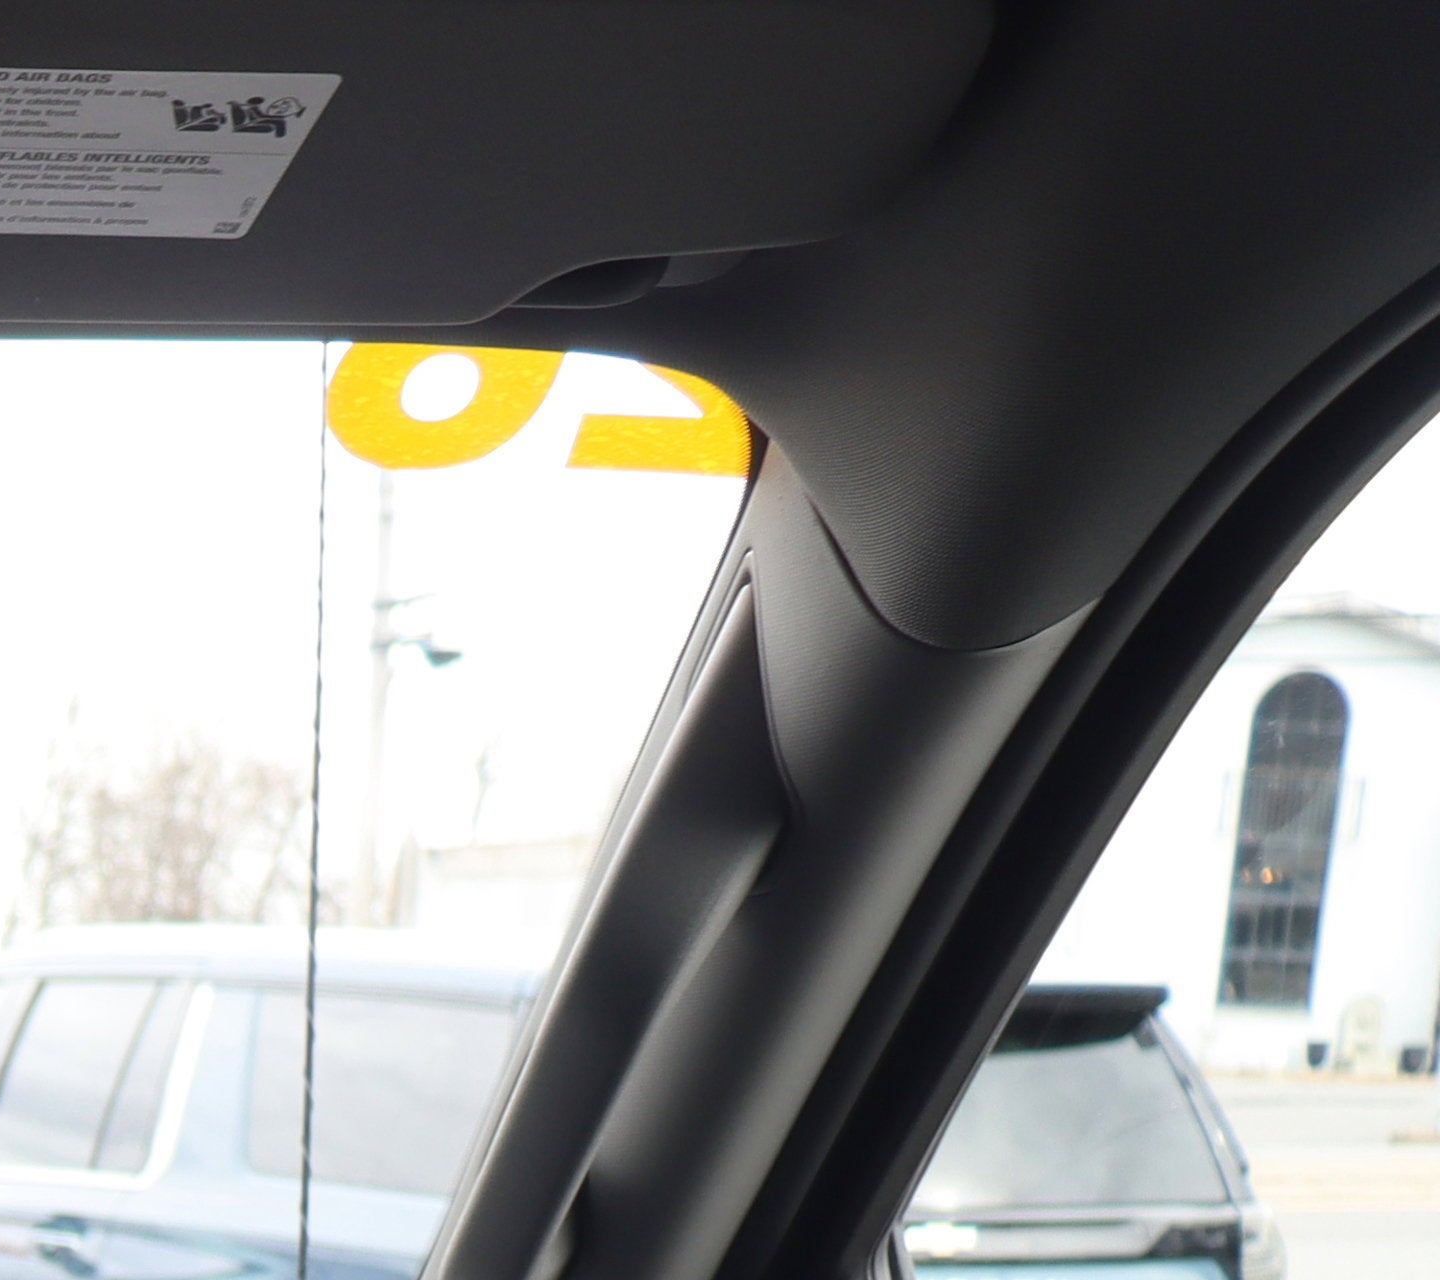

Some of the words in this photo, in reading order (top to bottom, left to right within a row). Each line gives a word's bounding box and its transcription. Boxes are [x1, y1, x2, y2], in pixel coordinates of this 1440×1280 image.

[14, 72, 50, 82] AIR
[55, 73, 112, 84] BAGS
[83, 153, 211, 166] INTELLIGENTS
